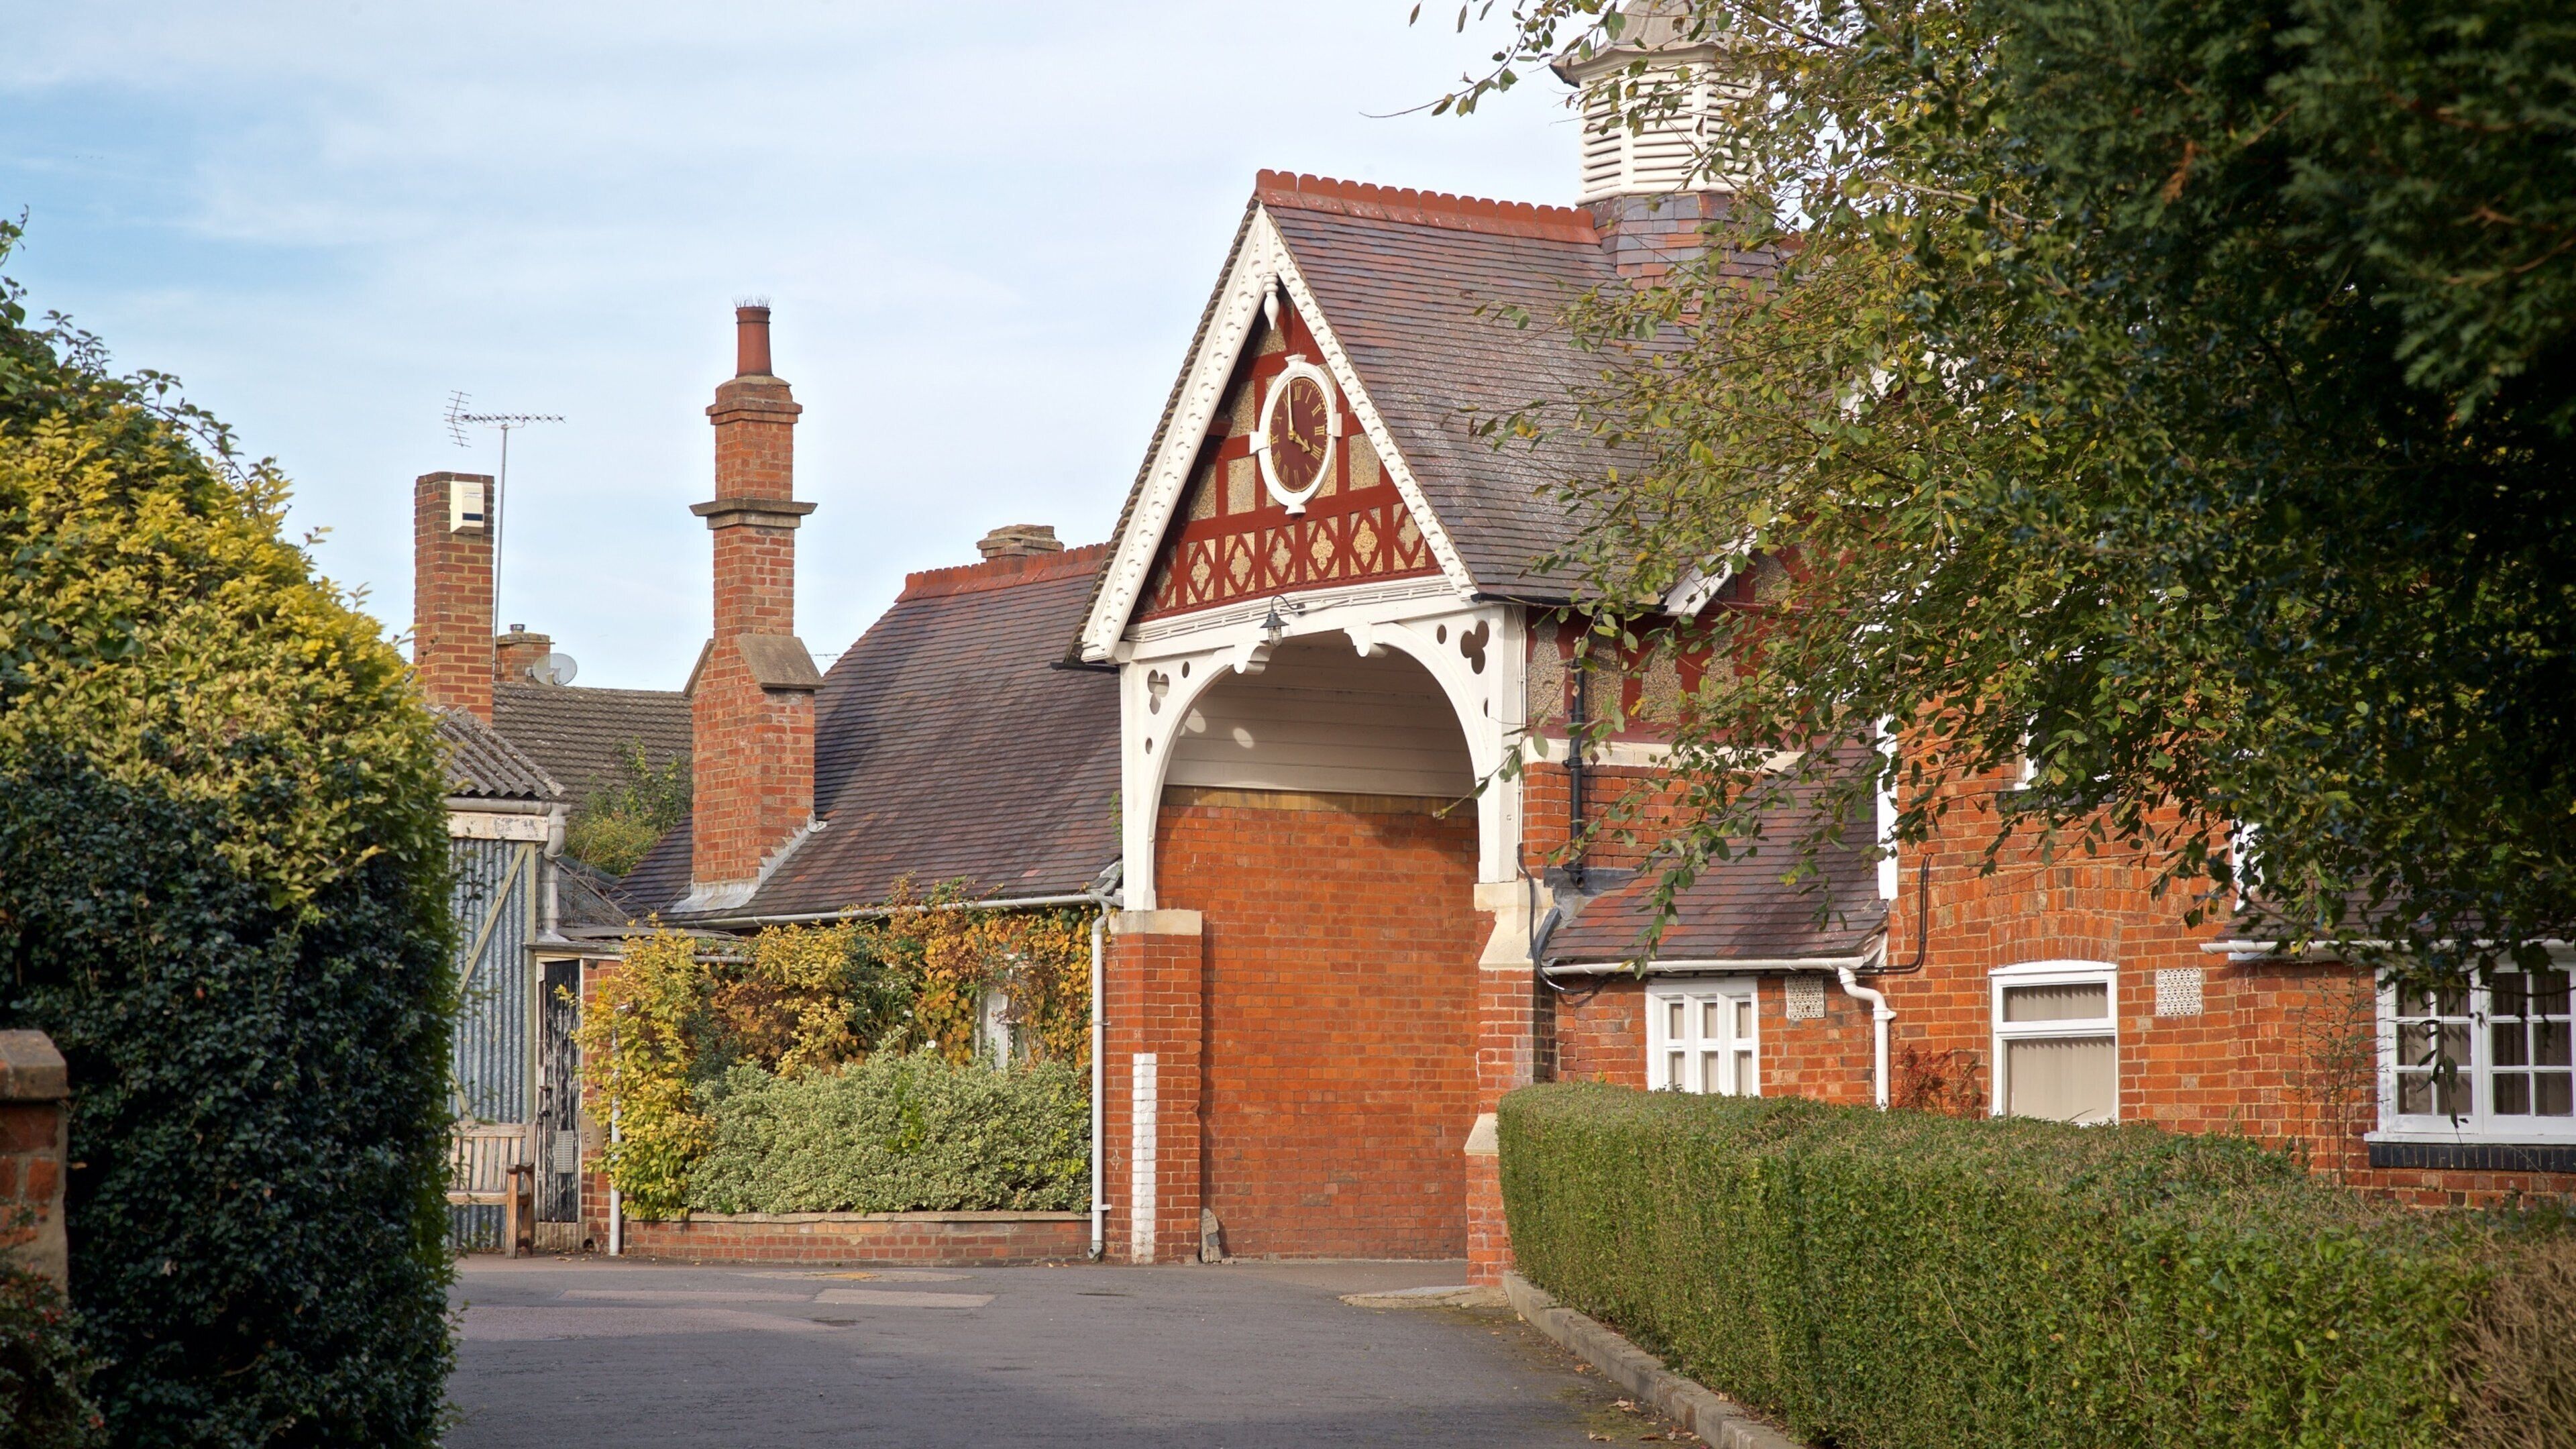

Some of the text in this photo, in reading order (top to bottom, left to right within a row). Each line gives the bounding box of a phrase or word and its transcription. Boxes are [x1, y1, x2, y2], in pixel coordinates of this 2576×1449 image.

[1305, 389, 1312, 403] I
[1311, 402, 1322, 417] II
[1314, 424, 1325, 436] III
[1310, 443, 1322, 460] IIII
